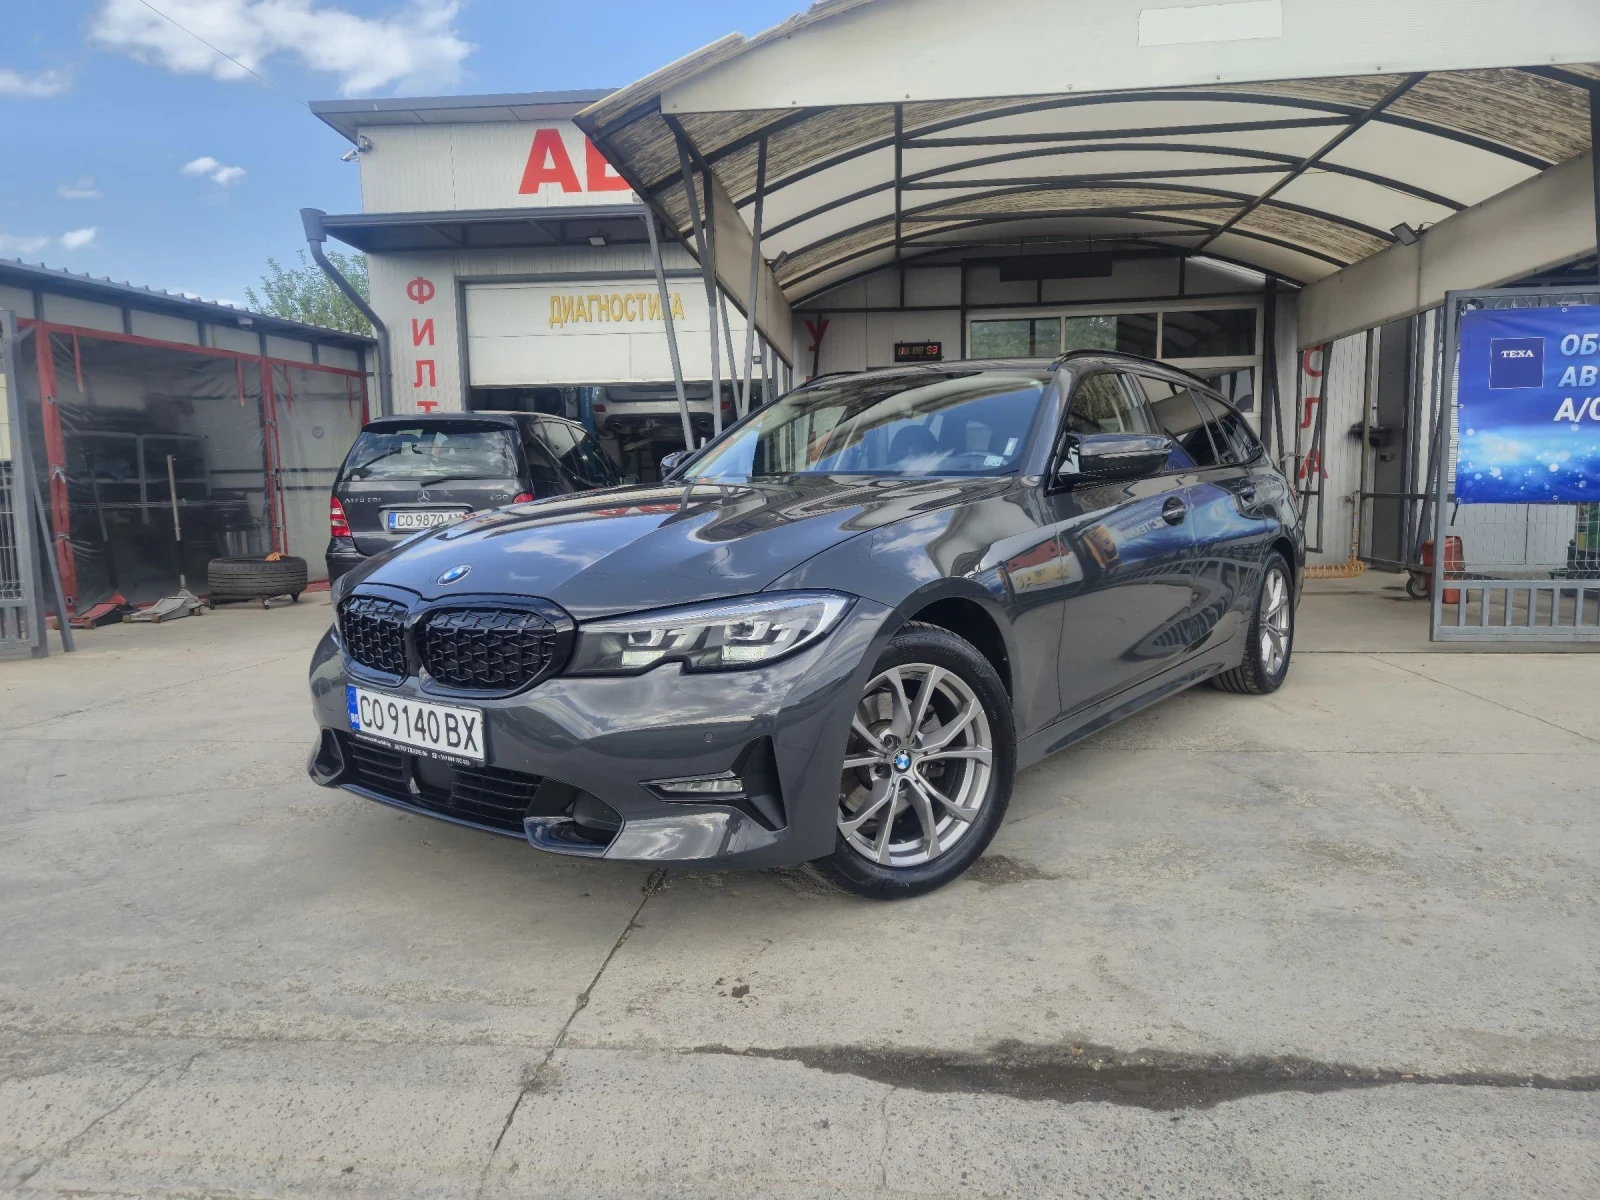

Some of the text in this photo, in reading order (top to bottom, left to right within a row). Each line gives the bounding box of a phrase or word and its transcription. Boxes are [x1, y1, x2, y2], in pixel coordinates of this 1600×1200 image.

[549, 292, 685, 328] ДИАГНОСТИА
[1501, 349, 1534, 358] TEXA
[1561, 333, 1600, 355] ОБ
